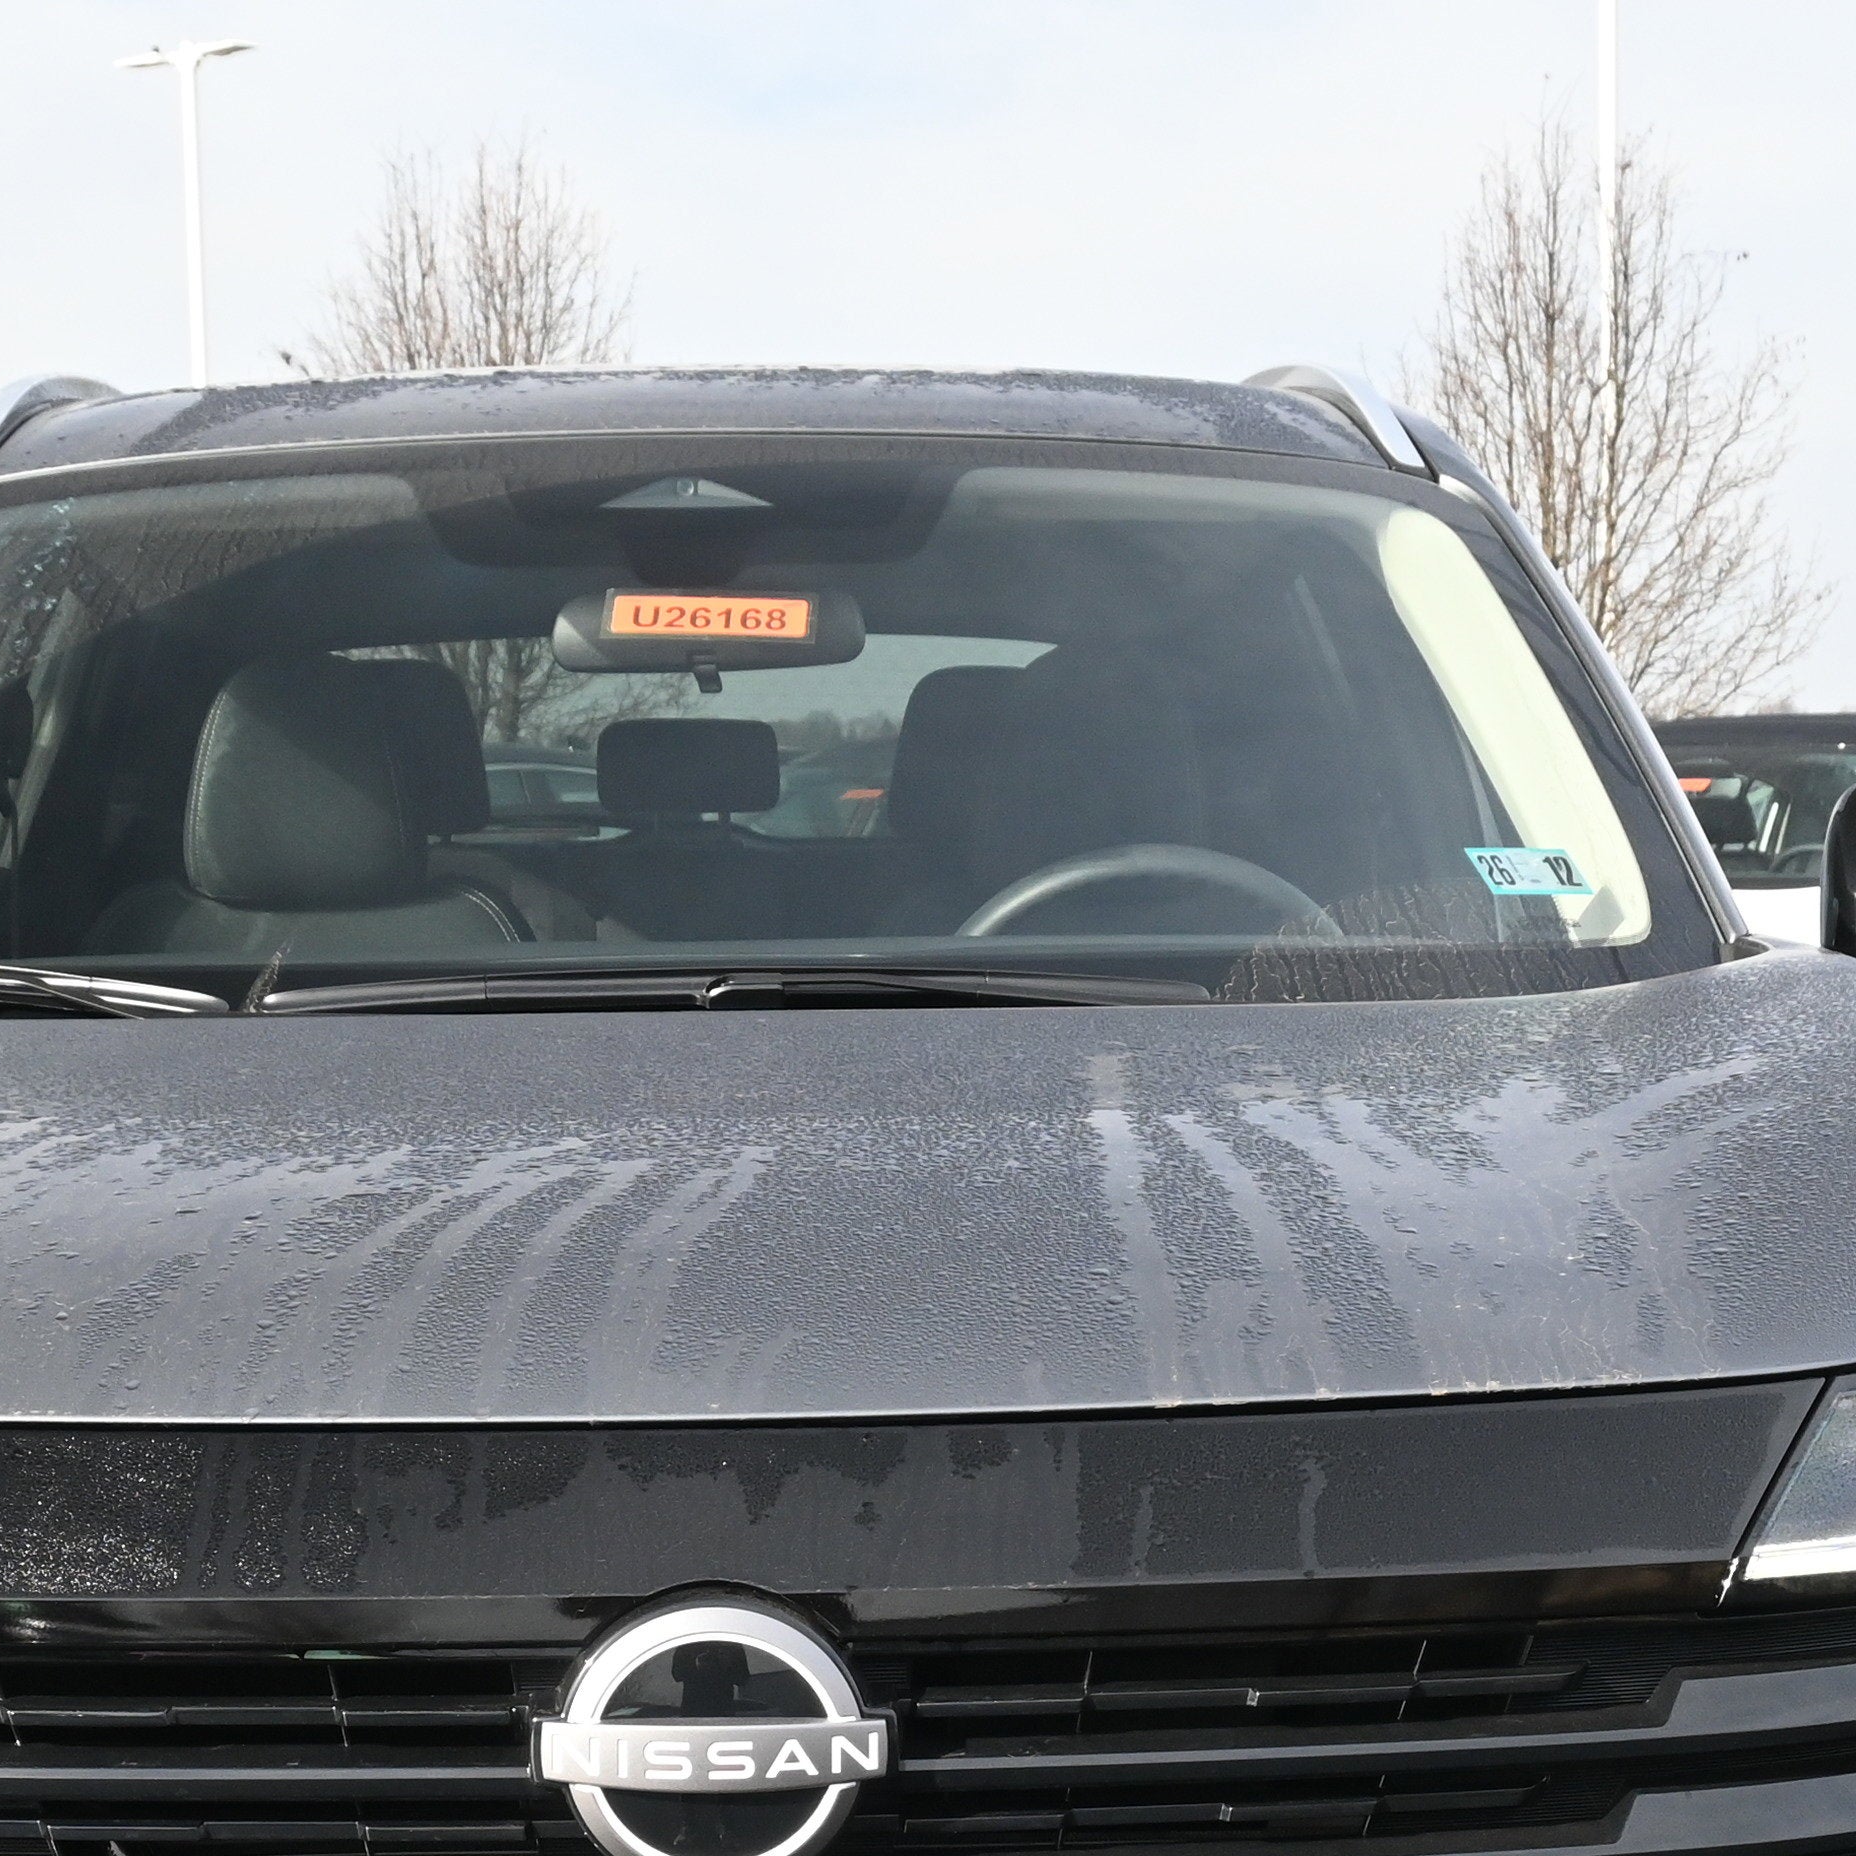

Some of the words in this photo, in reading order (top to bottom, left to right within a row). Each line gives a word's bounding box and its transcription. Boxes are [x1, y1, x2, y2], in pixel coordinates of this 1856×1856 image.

[632, 605, 787, 631] U26168
[1476, 855, 1517, 886] 26
[1542, 855, 1584, 887] 12
[550, 1731, 880, 1781] NISSAN
